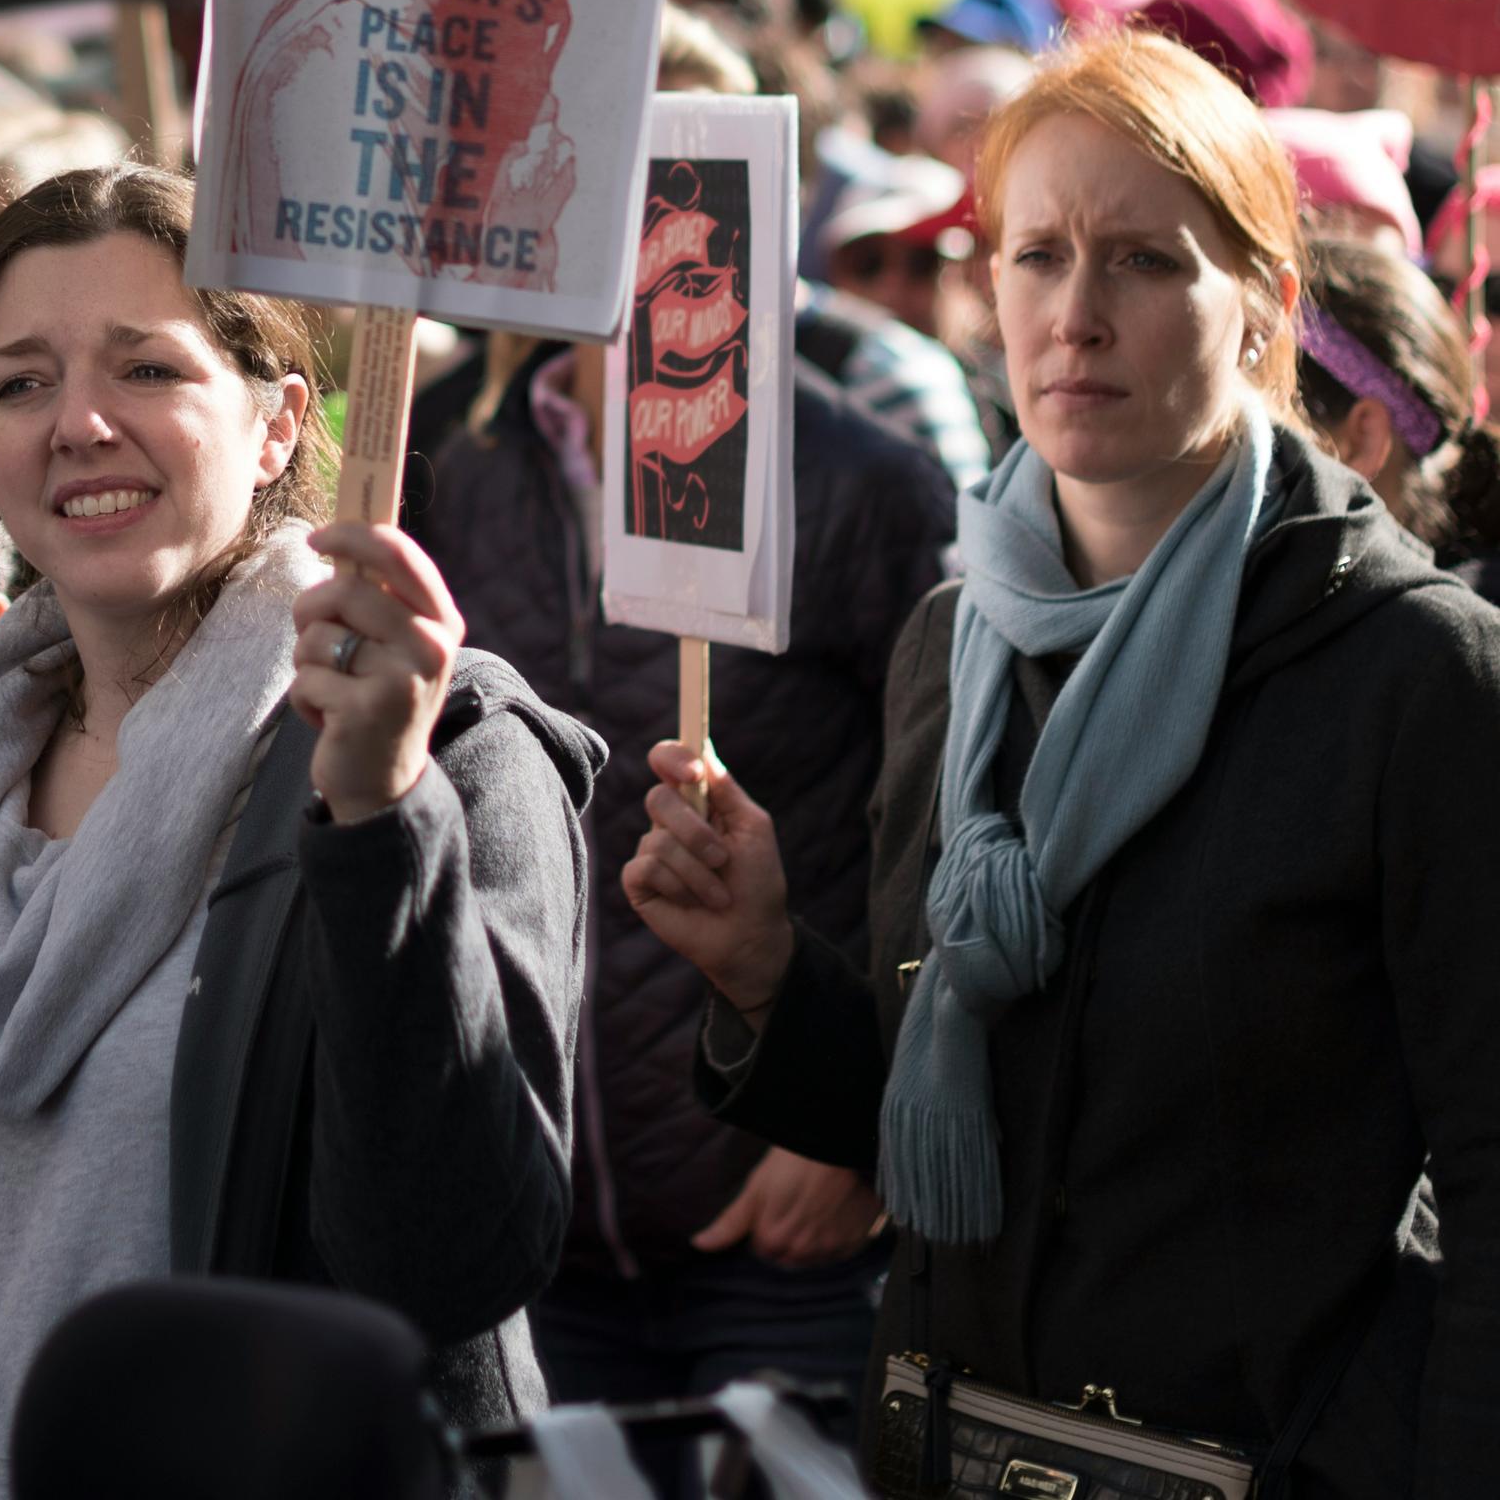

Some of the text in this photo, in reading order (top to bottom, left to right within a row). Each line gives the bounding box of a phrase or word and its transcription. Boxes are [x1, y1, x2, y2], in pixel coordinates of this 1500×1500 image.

[358, 4, 499, 62] PLACE
[354, 58, 492, 129] IS IN
[350, 128, 485, 209] THE
[274, 198, 541, 272] RESISTANCE
[655, 307, 687, 344] OUR
[633, 377, 731, 449] OUR POWER
